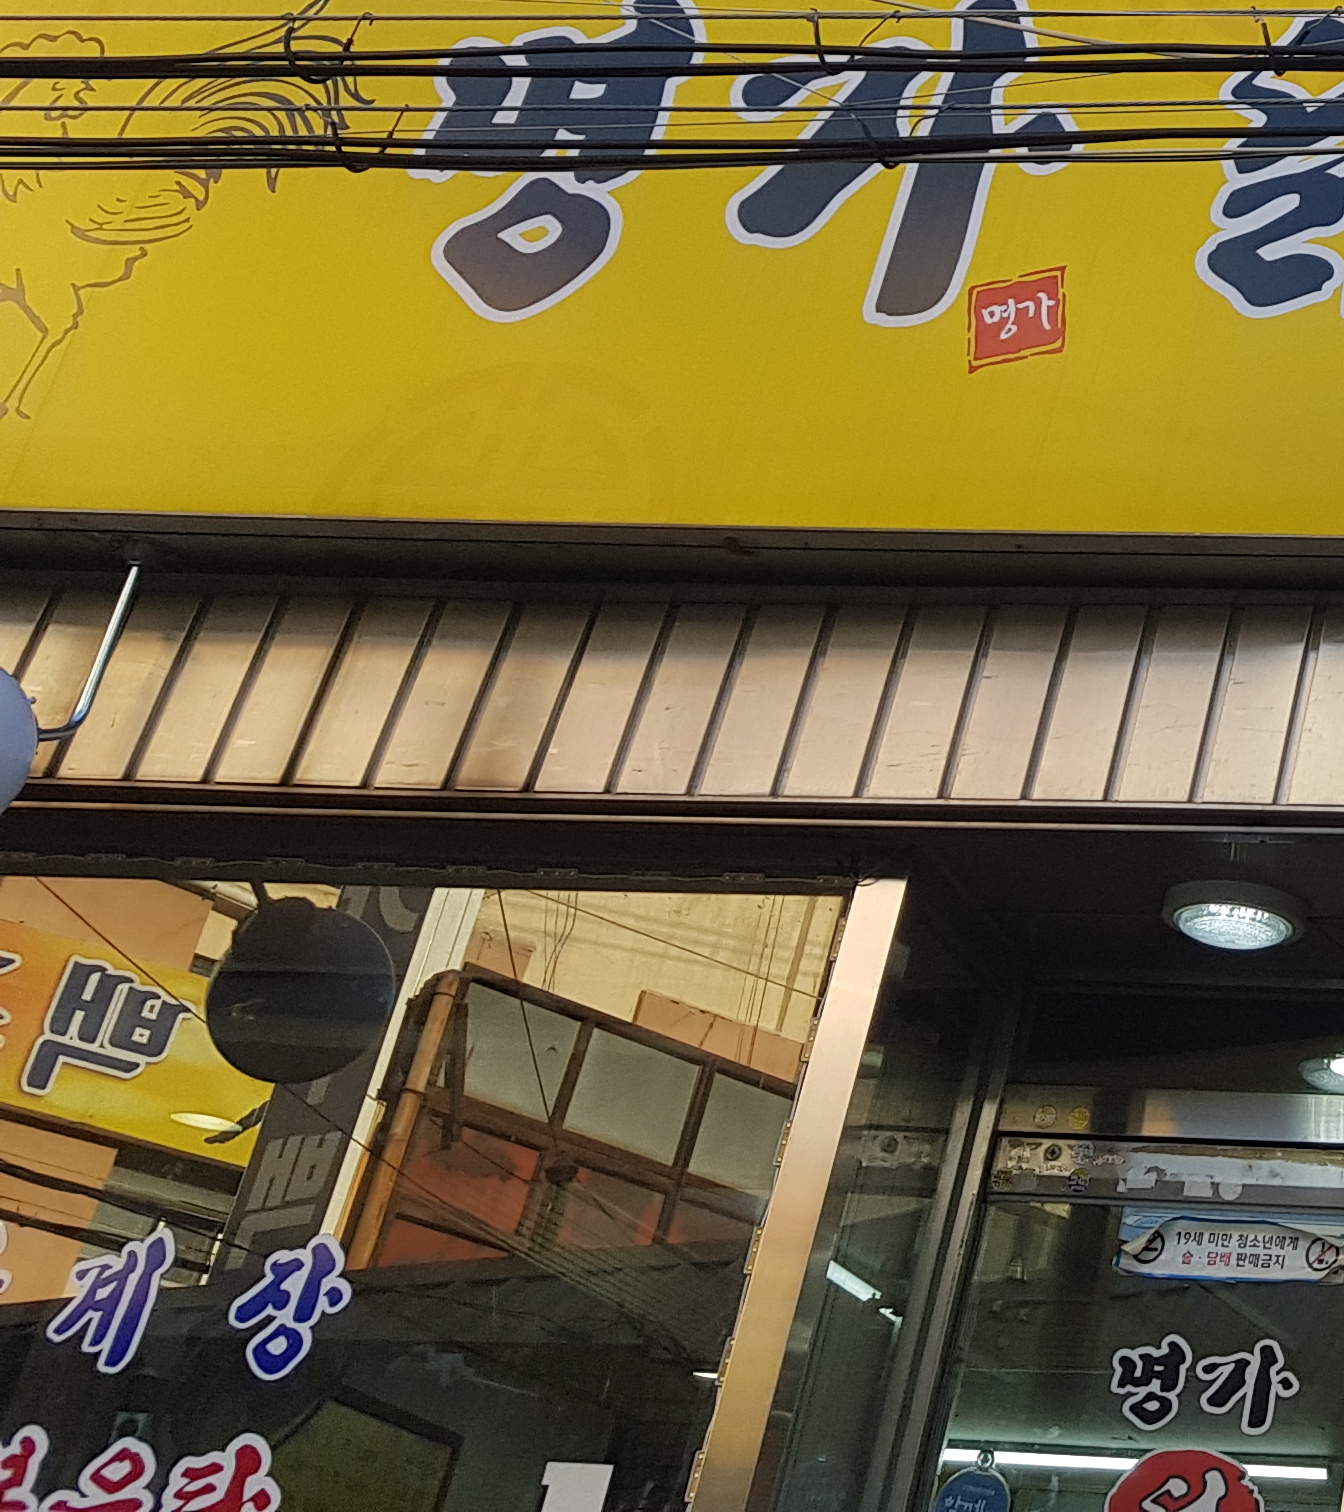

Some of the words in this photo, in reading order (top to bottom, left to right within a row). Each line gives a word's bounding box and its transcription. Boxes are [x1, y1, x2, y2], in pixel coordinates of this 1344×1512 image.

[981, 292, 1056, 340] 명가
[1175, 1231, 1204, 1246] 19세
[1207, 1232, 1233, 1248] 미만
[1236, 1233, 1299, 1251] 청소년에게
[1206, 1251, 1232, 1267] 담배
[1235, 1252, 1286, 1270] 판매금지
[1111, 1333, 1300, 1435] 명가
